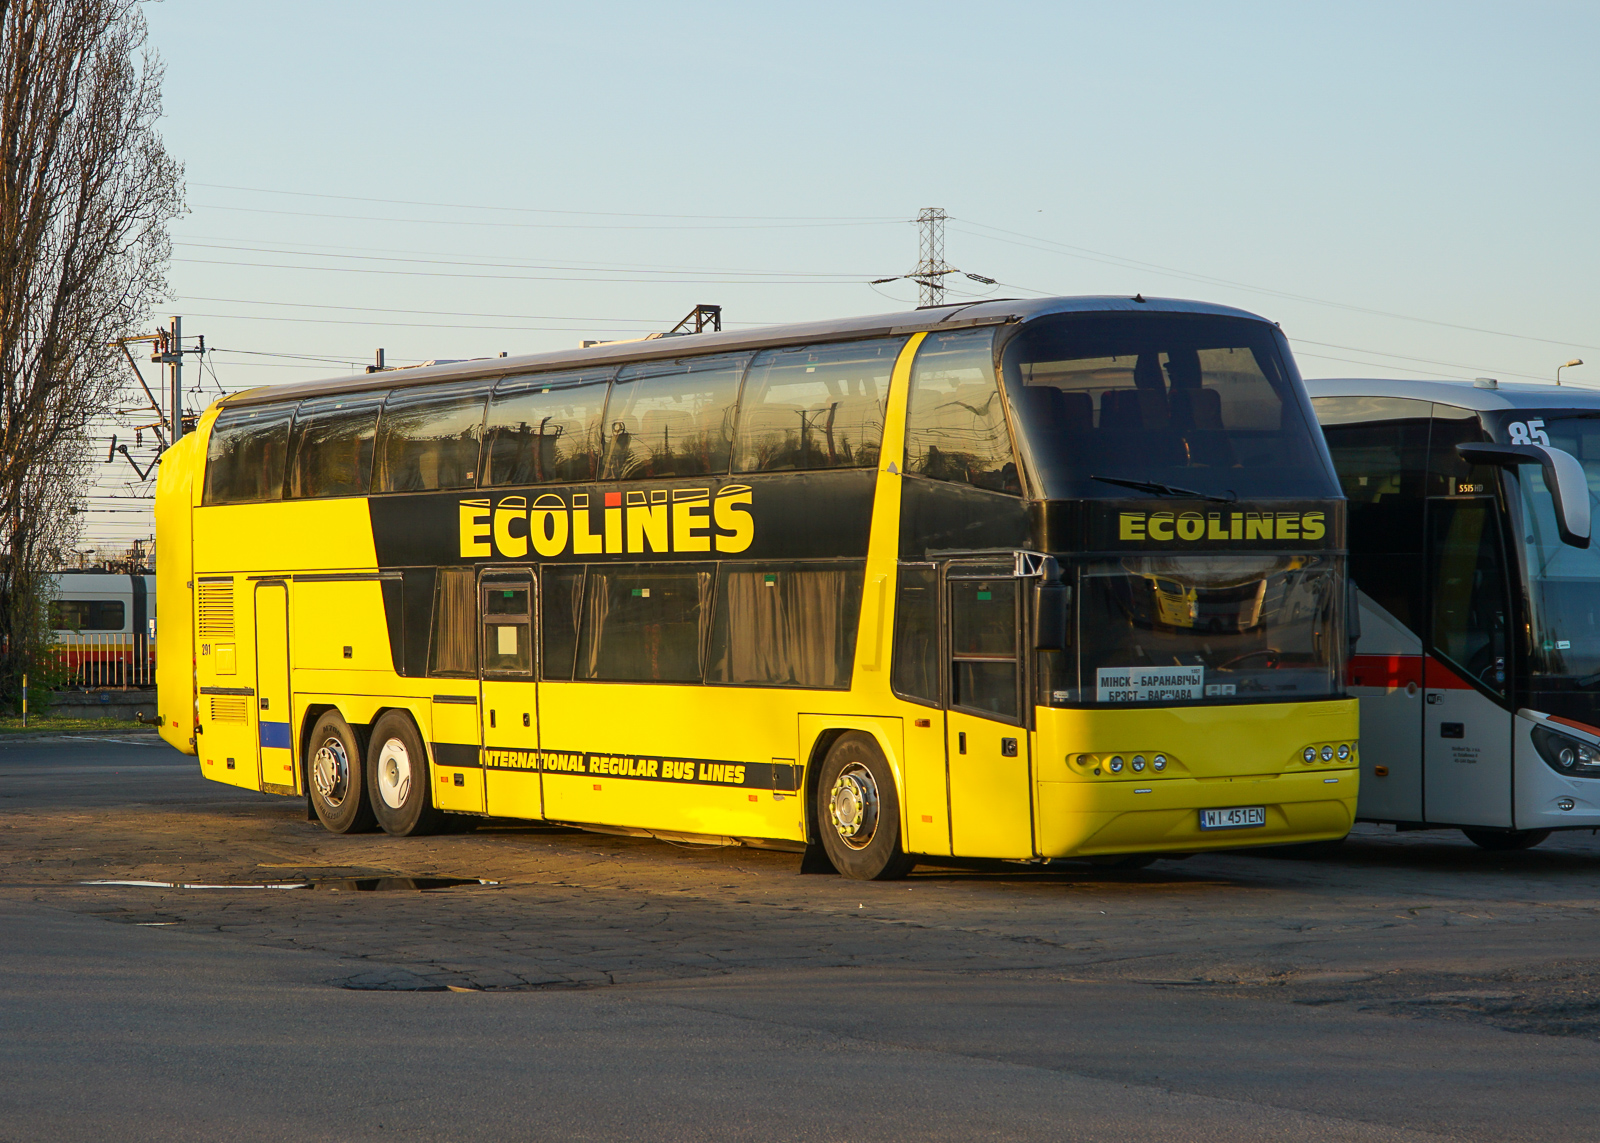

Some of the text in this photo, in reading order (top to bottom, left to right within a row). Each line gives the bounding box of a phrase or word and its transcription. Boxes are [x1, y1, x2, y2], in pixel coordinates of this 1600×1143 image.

[1508, 420, 1550, 446] 85
[459, 484, 755, 558] ECOLINES
[1119, 511, 1326, 541] ECOLINES
[201, 643, 211, 656] 291
[1101, 676, 1131, 688] МІНСК
[1141, 674, 1201, 687] БАРАНАВІЧЫ
[1108, 690, 1139, 702] БРЭСТ
[478, 748, 746, 784] INTERNATIONAL REGULAR BUS LINES
[1207, 808, 1263, 826] WI 451EN
